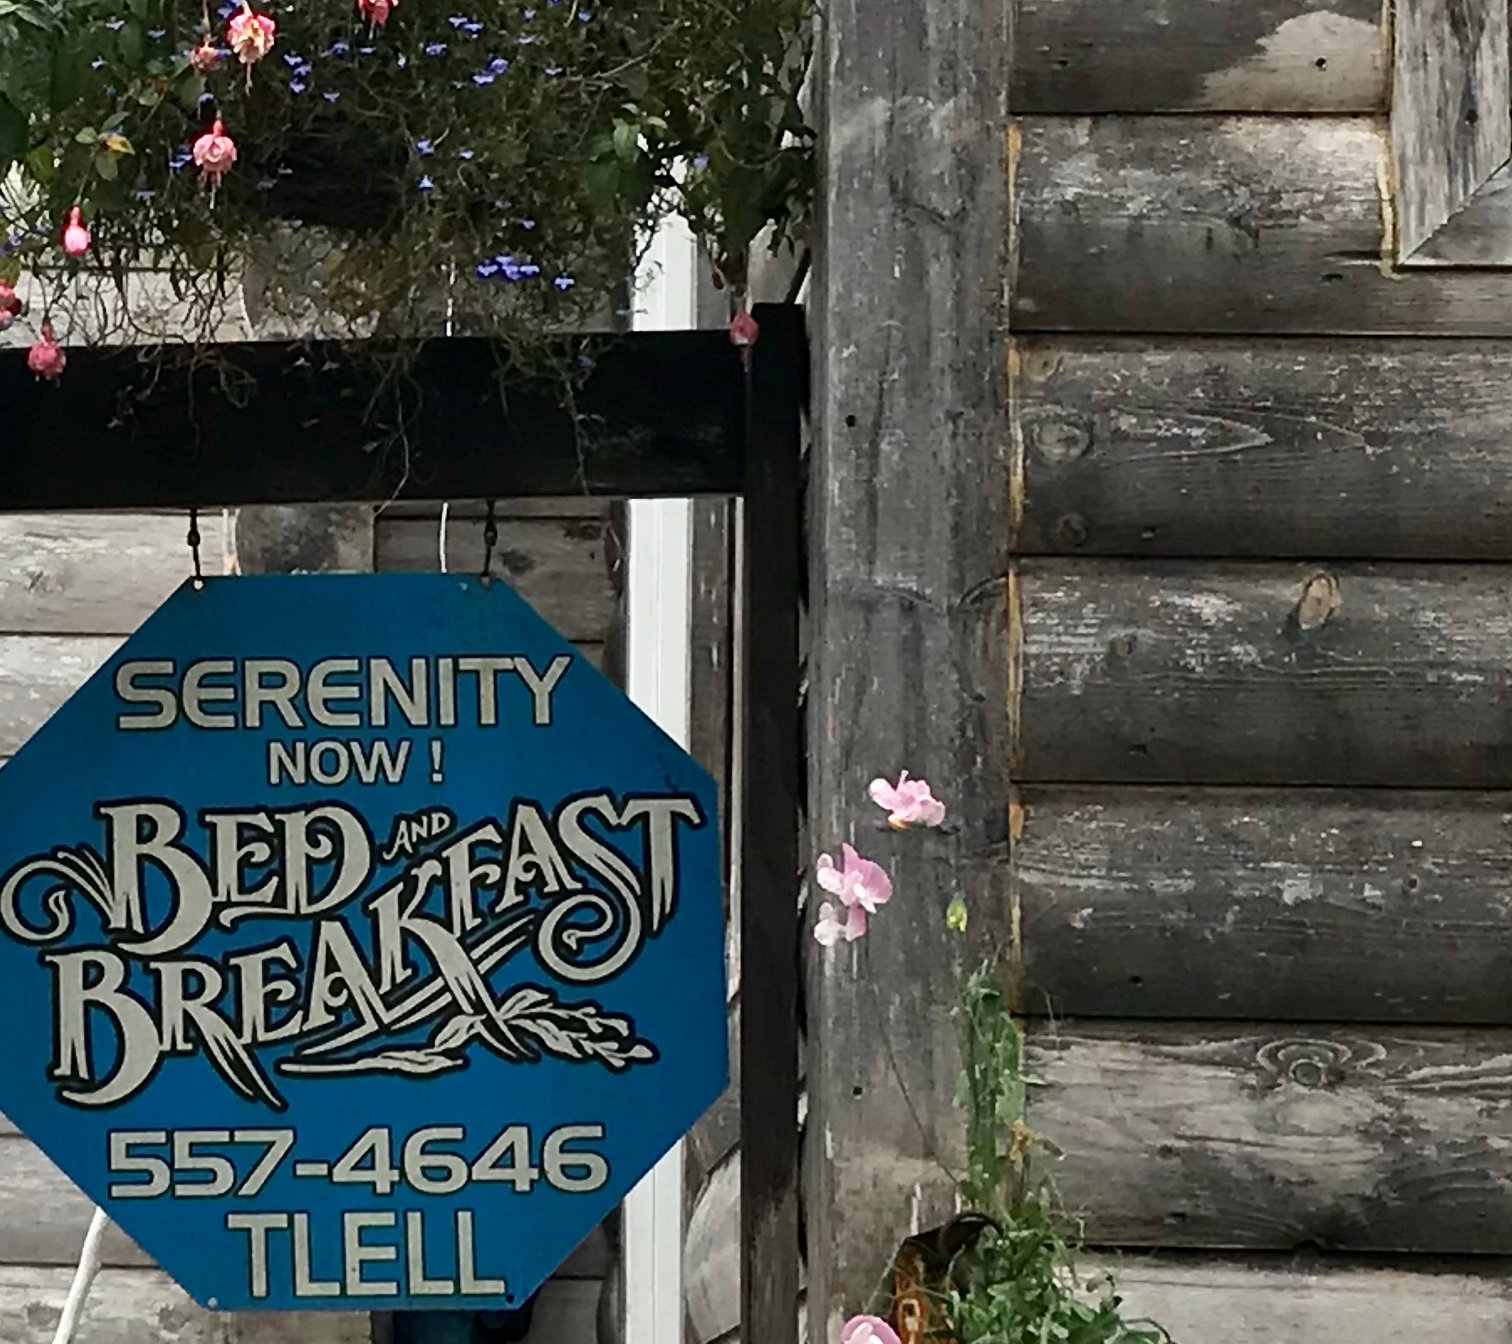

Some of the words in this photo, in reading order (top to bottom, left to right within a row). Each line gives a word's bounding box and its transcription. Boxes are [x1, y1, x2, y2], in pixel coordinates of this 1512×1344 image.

[115, 657, 571, 729] SERENITY
[269, 741, 410, 785] NOW
[0, 800, 371, 953] BED
[383, 811, 451, 861] AND
[109, 1125, 609, 1199] 557-4646
[227, 1211, 506, 1298] TLELL
